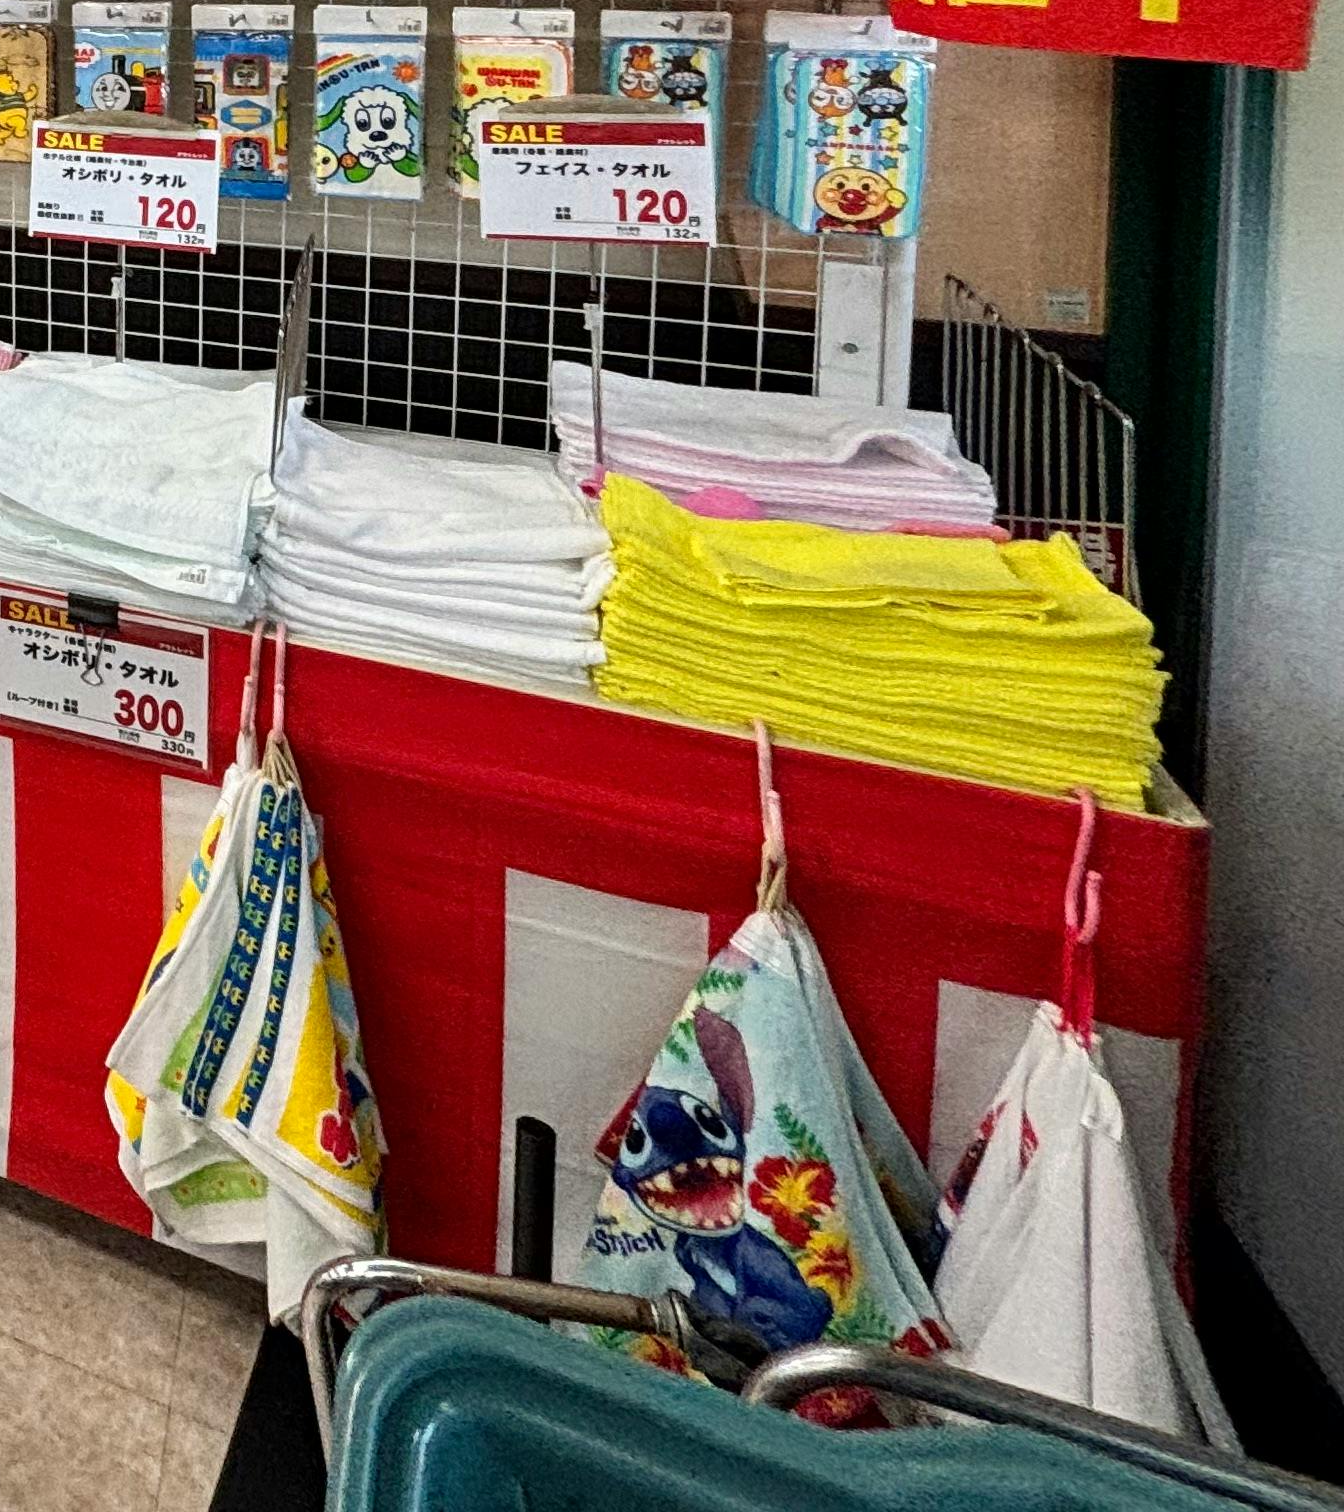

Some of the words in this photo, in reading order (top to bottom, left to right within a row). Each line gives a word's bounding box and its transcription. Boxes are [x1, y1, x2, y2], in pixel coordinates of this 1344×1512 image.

[43, 130, 105, 151] SALE
[490, 124, 563, 143] SALE
[515, 161, 671, 179] フェイス・タオル
[8, 600, 76, 631] SALE
[161, 738, 195, 757] 330円
